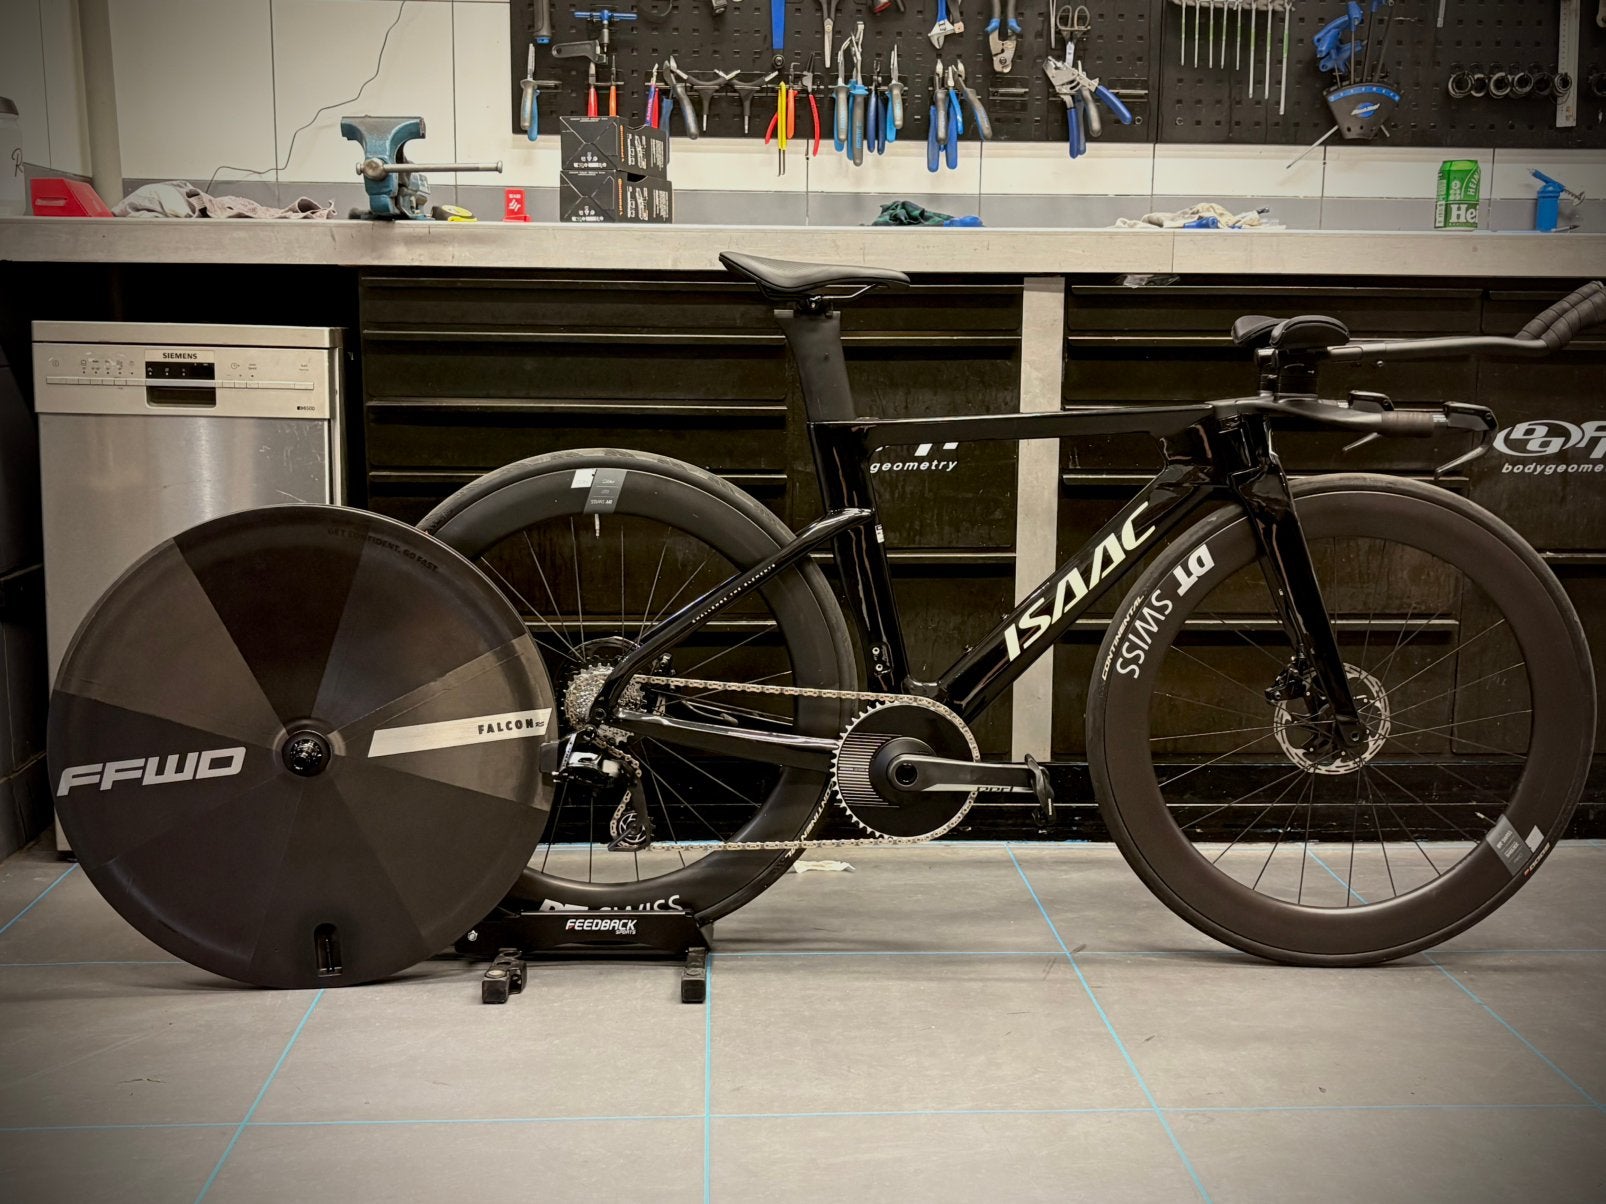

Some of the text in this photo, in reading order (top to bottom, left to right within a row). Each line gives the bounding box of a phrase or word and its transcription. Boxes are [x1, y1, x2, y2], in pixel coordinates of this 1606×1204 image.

[162, 352, 198, 360] SIEMENS
[869, 459, 958, 474] geometry
[1501, 462, 1606, 475] bodygeome
[1004, 501, 1156, 662] ISAAC
[1116, 544, 1216, 679] DT SWISS
[1101, 595, 1145, 681] CONTINENTAL
[477, 718, 534, 735] FALCON
[56, 746, 247, 797] FFWD
[565, 919, 638, 931] FEEDBACK
